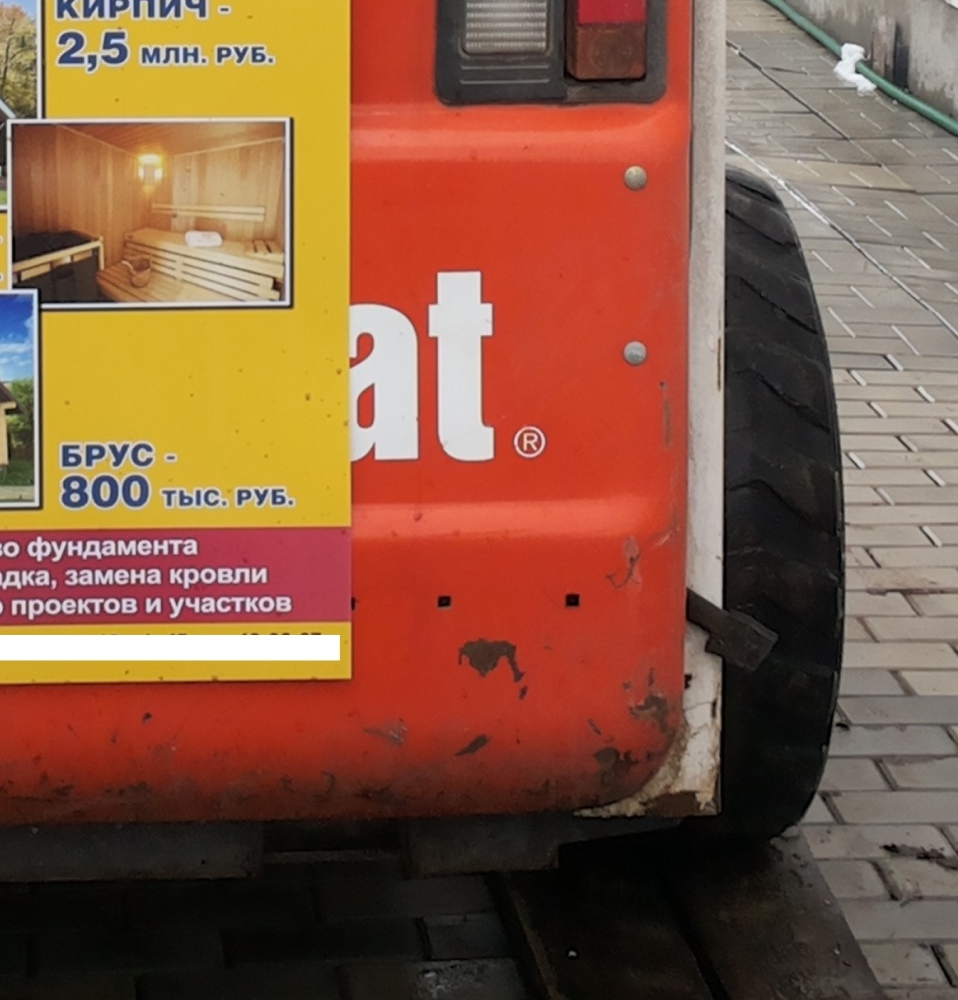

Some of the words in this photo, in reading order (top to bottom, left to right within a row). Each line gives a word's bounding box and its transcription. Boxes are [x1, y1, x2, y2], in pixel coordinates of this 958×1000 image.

[57, 32, 129, 71] 2,5
[141, 45, 207, 65] МЛН.
[216, 46, 275, 65] РУБ.
[61, 444, 154, 467] БРУС
[61, 475, 150, 508] 800
[162, 489, 228, 507] ТЫС.
[237, 489, 295, 506] РУБ.
[27, 536, 198, 561] фундамента
[64, 567, 162, 586] замена
[170, 566, 268, 587] кровли
[11, 596, 138, 619] проектов
[145, 598, 162, 614] и
[169, 595, 292, 617] участков
